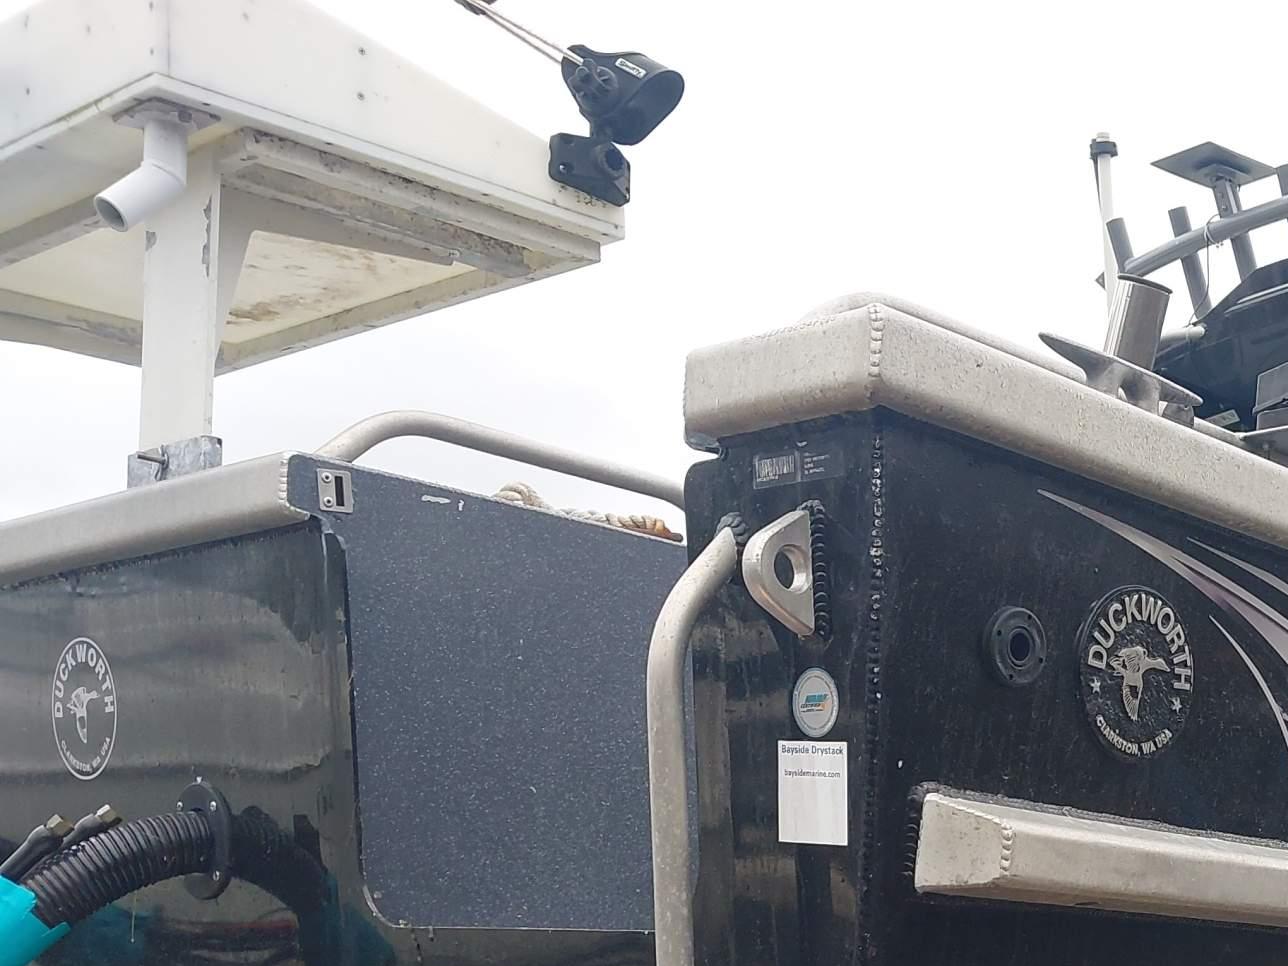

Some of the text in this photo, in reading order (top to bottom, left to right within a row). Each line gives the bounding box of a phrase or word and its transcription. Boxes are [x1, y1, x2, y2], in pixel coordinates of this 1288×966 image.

[1087, 593, 1192, 691] DUCKWORTH
[54, 643, 115, 718] DUCKWORTH
[781, 744, 844, 756] Bayside Drystack
[1096, 714, 1173, 757] CLARKSTON, WA USA
[784, 768, 841, 778] baysidemarine.com
